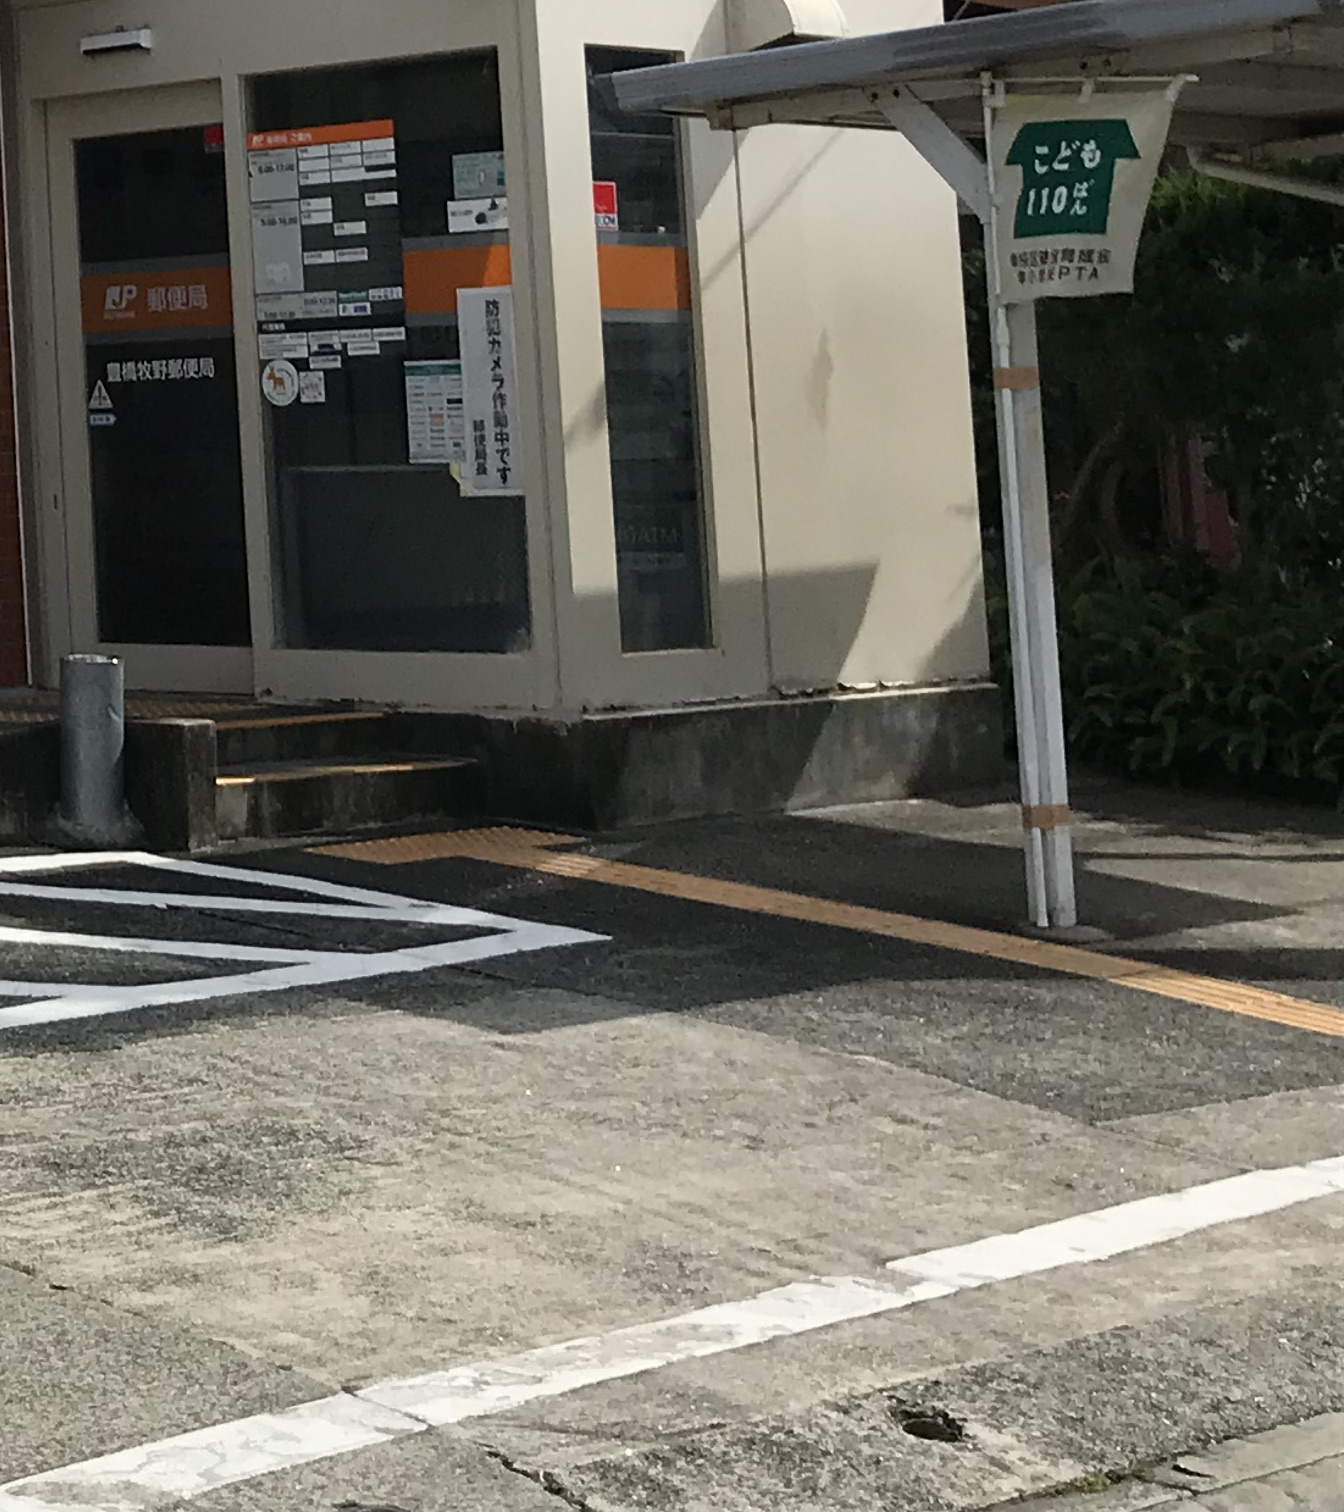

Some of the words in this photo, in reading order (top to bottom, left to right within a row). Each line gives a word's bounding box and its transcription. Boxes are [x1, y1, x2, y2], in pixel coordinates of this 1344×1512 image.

[1035, 140, 1102, 174] こども
[147, 285, 208, 312] 郵便局
